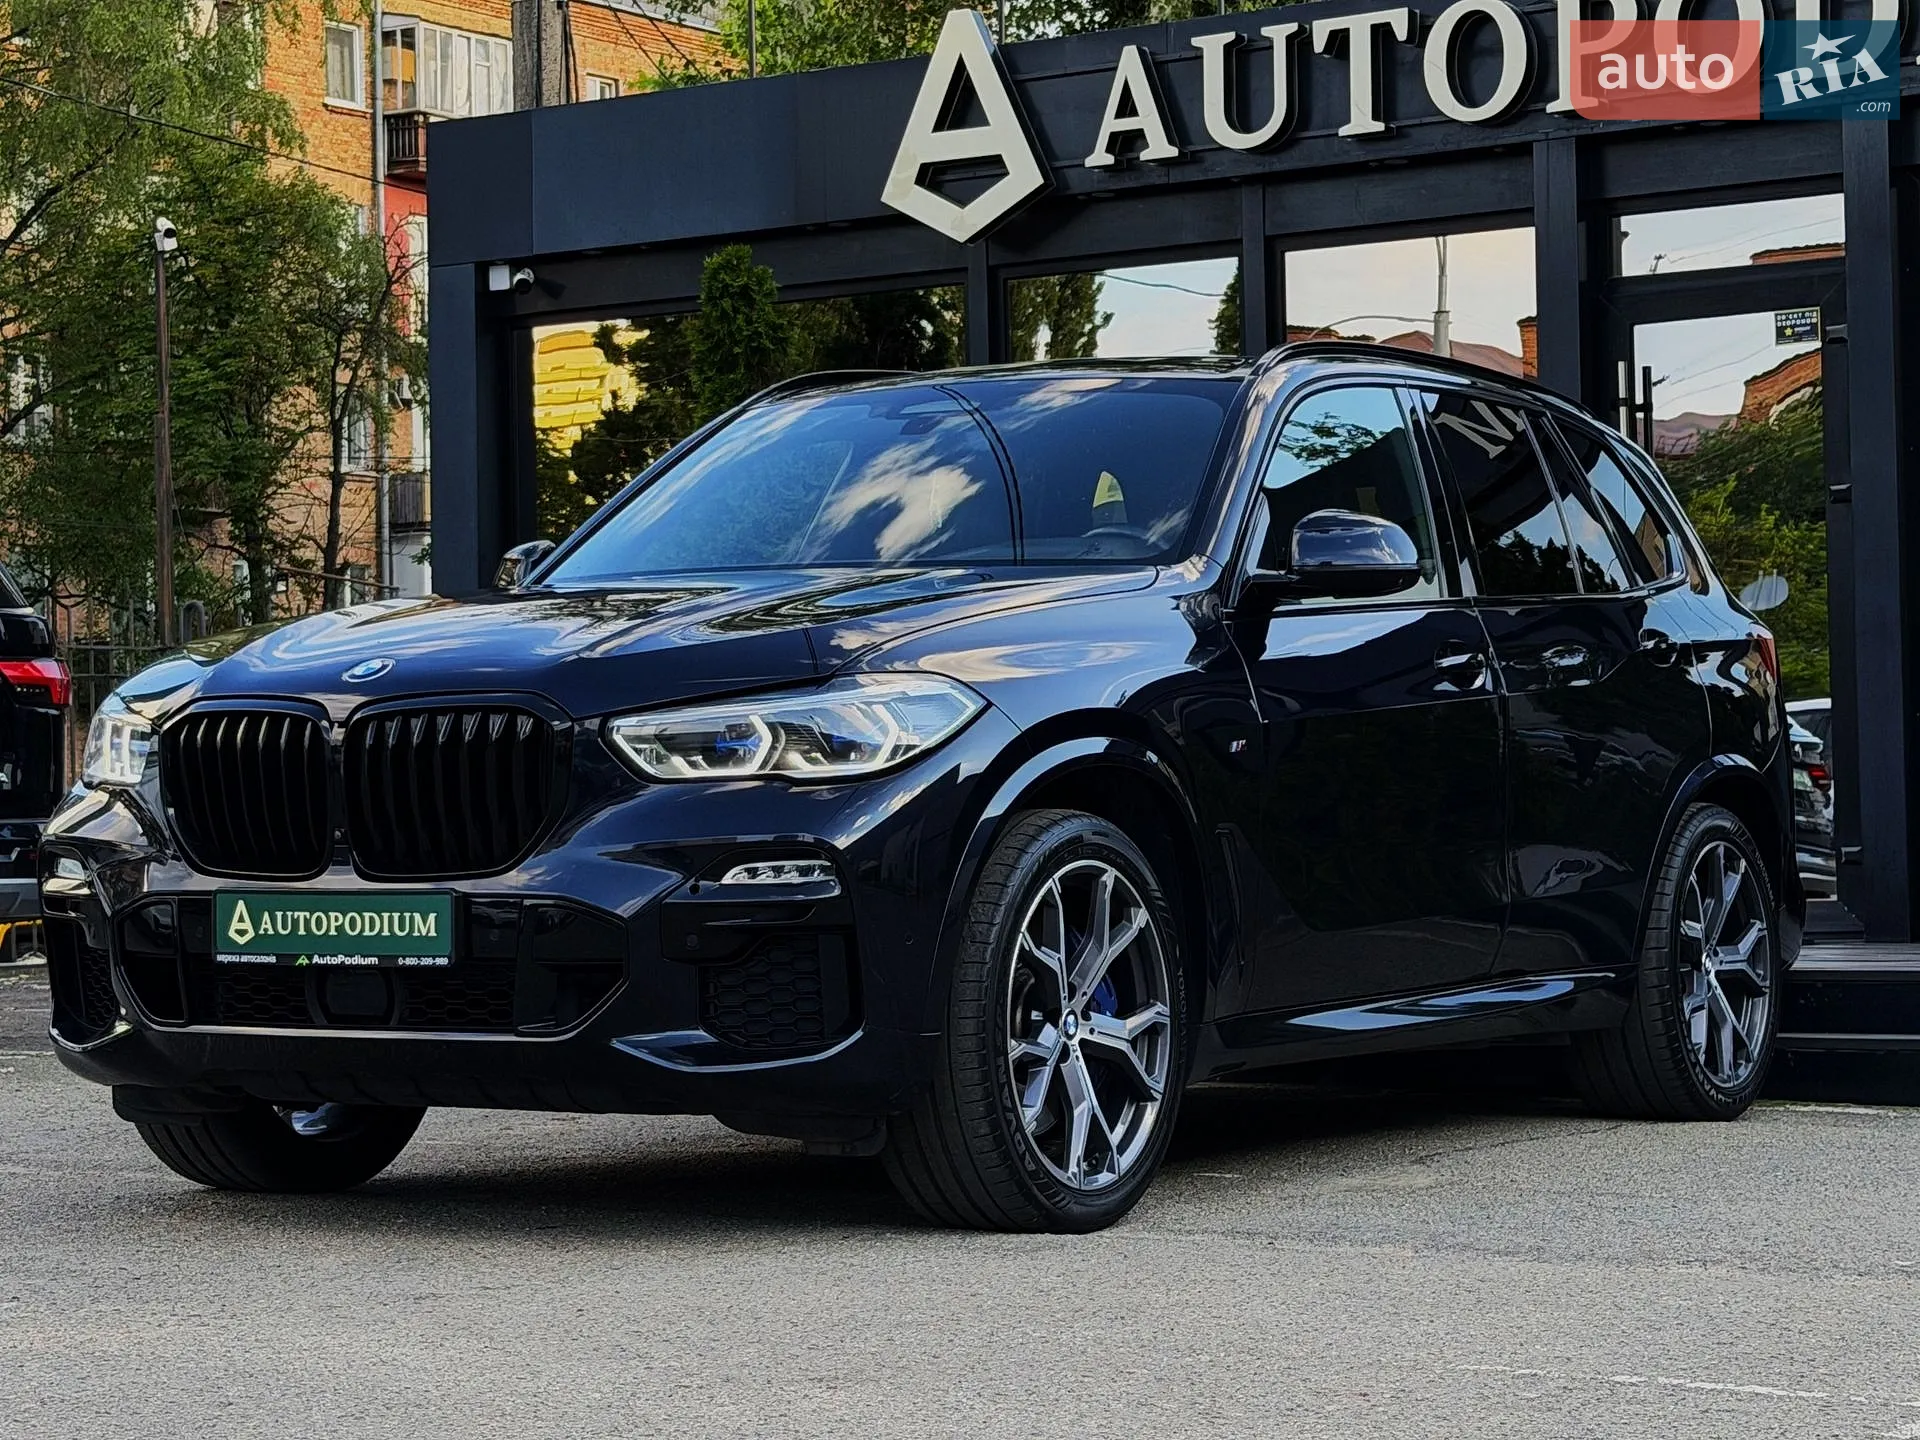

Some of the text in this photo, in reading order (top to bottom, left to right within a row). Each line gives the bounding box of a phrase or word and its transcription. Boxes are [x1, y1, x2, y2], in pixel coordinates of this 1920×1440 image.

[1084, 0, 1920, 169] AUTOPOD
[257, 910, 438, 937] AUTOPODIUM
[311, 953, 379, 966] AutoPodium
